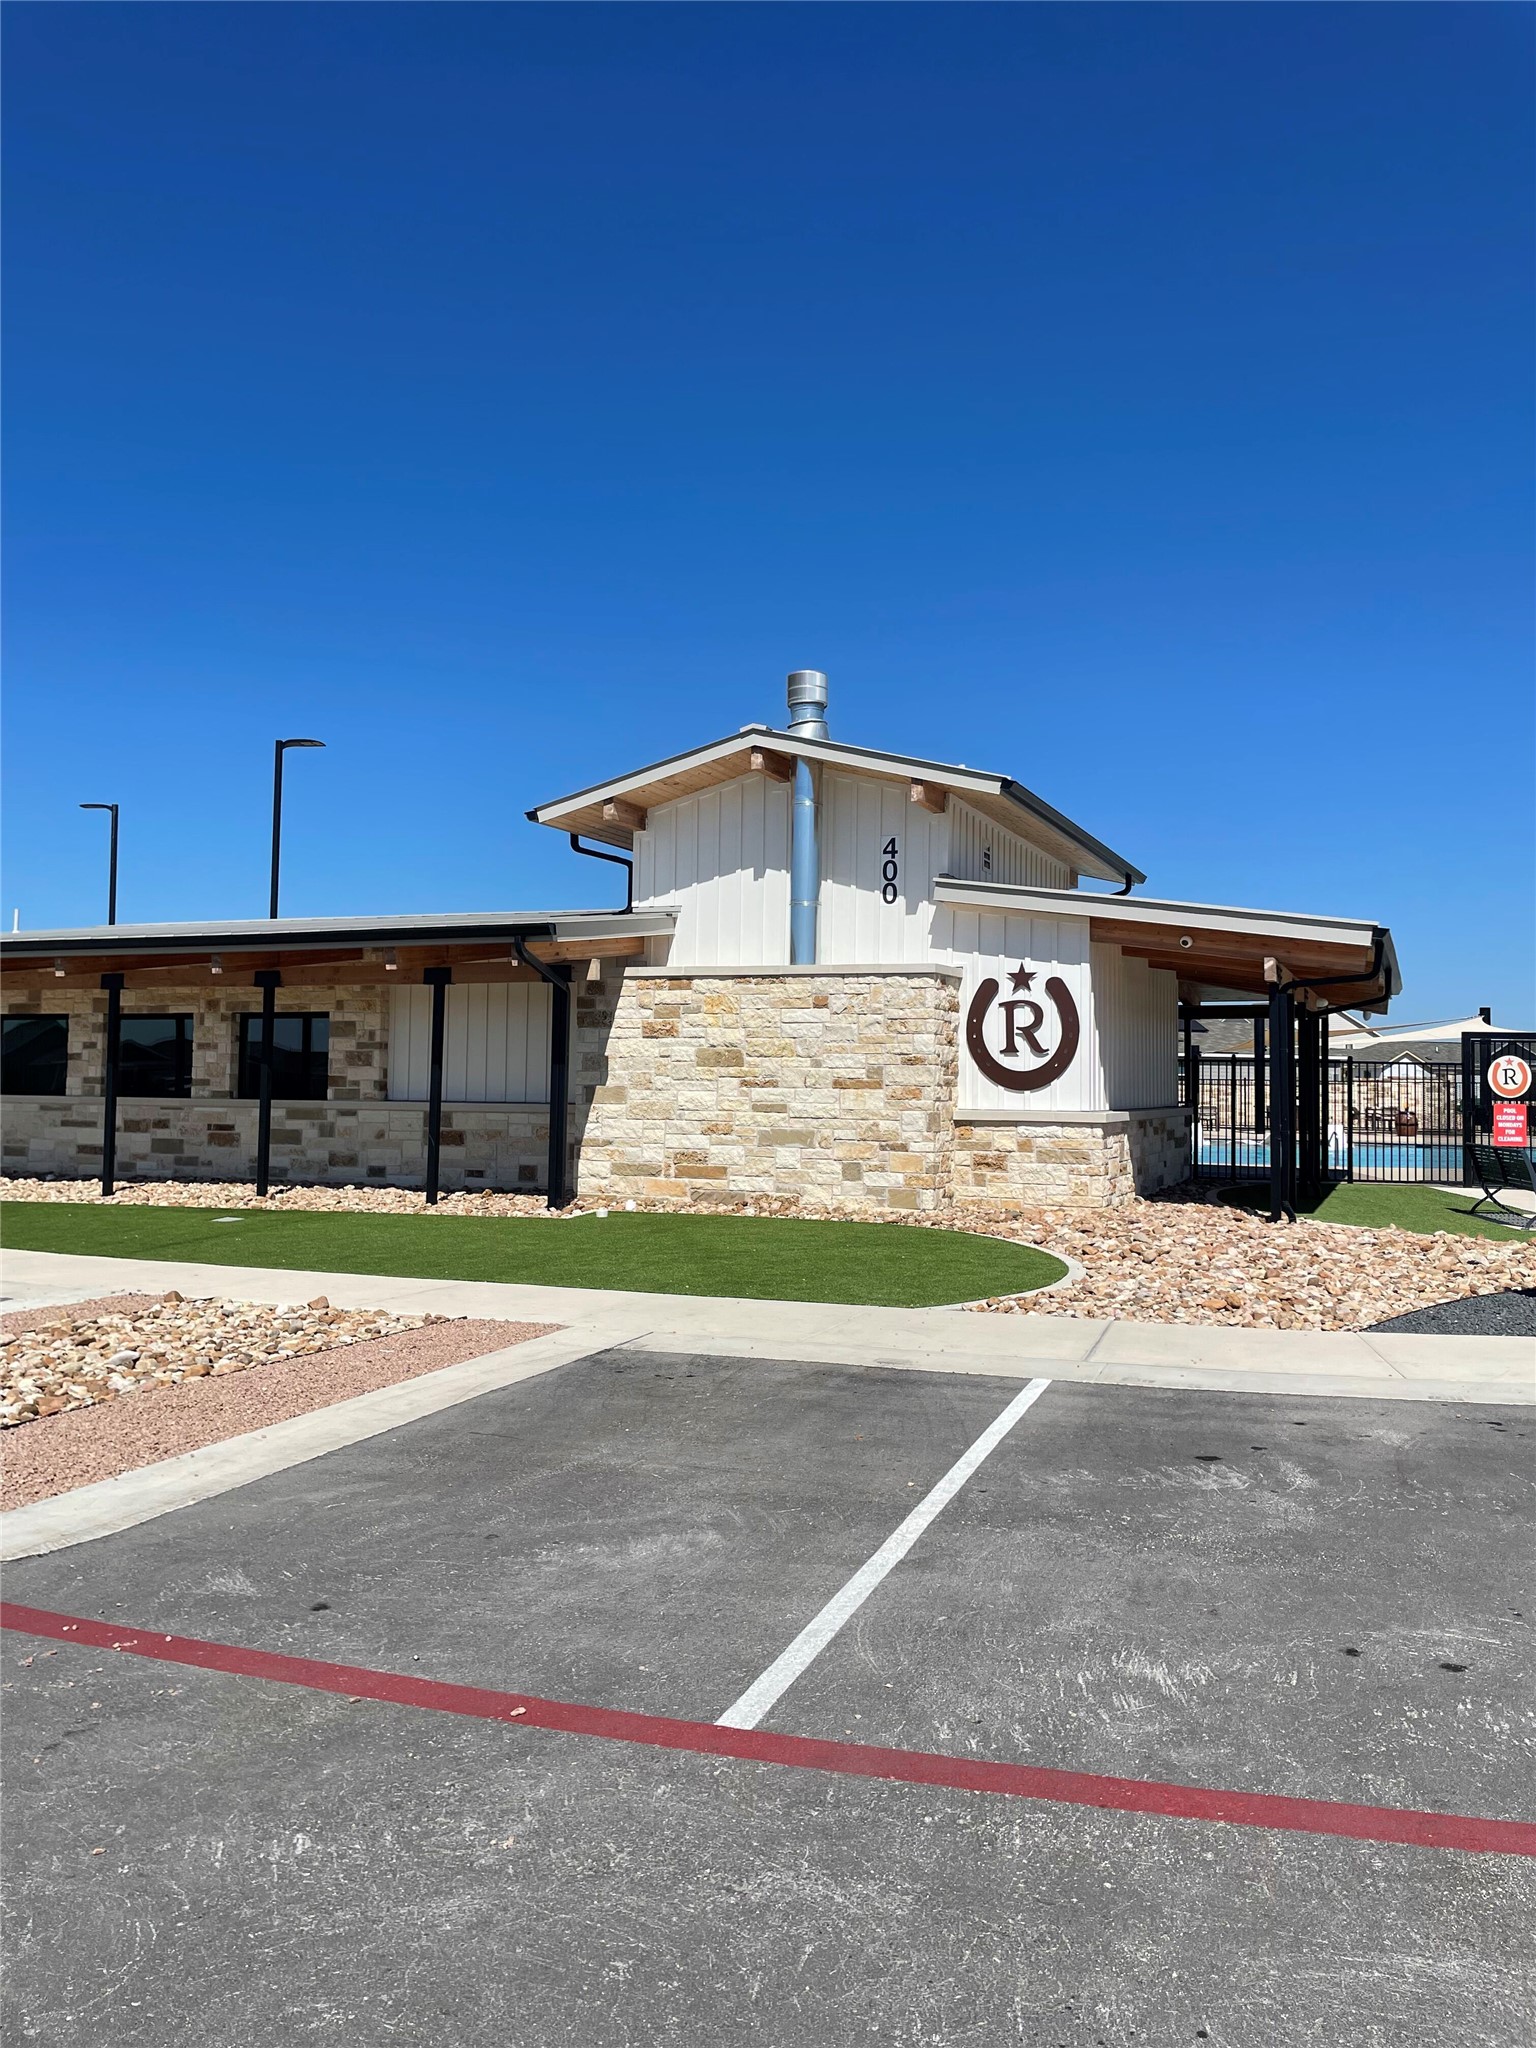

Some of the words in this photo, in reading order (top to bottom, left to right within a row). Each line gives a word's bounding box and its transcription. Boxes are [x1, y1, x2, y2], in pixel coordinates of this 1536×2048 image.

[882, 837, 898, 904] 400
[998, 1000, 1049, 1054] R
[1502, 1068, 1518, 1085] R
